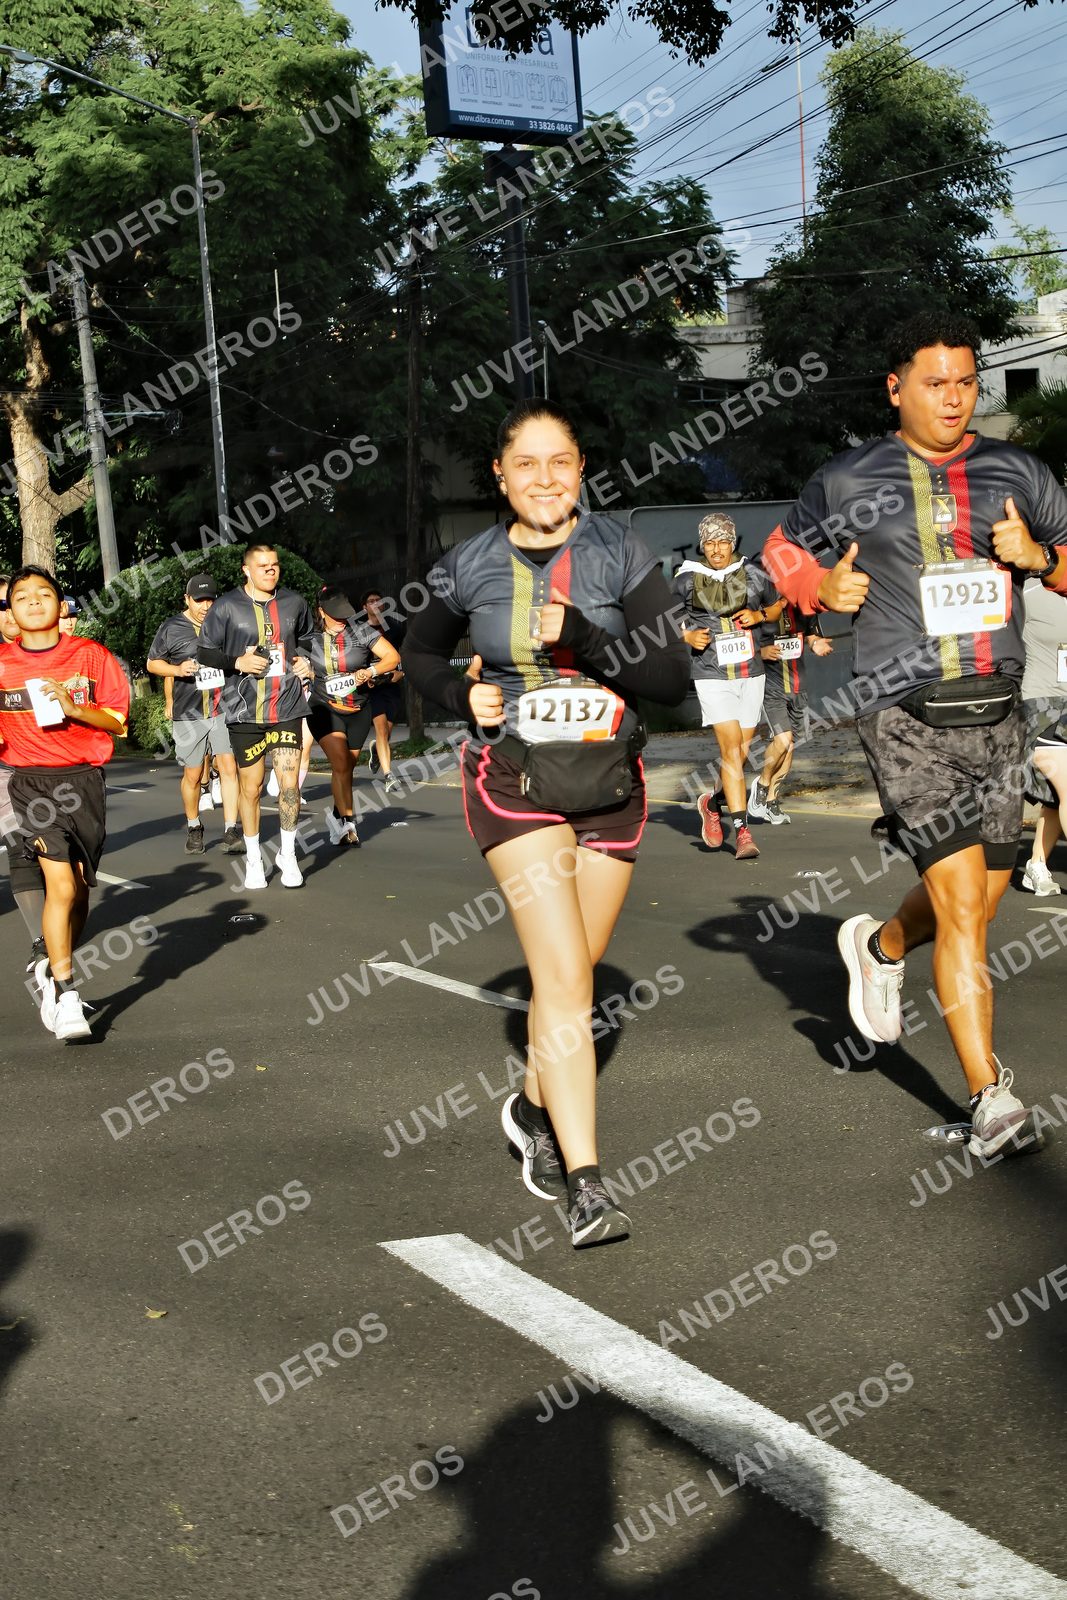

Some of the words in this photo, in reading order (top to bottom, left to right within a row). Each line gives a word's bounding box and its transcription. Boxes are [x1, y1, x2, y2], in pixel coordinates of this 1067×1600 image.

[466, 53, 505, 64] UNIFORMES
[458, 114, 515, 126] www.dibra.com.mx
[528, 120, 538, 129] 33
[538, 121, 556, 131] 3826
[555, 123, 573, 133] 4845
[926, 580, 999, 608] 12923
[722, 641, 746, 654] 8018
[779, 641, 800, 652] 2456
[327, 678, 354, 693] 12240
[525, 698, 609, 722] 12137
[244, 738, 267, 762] JUS
